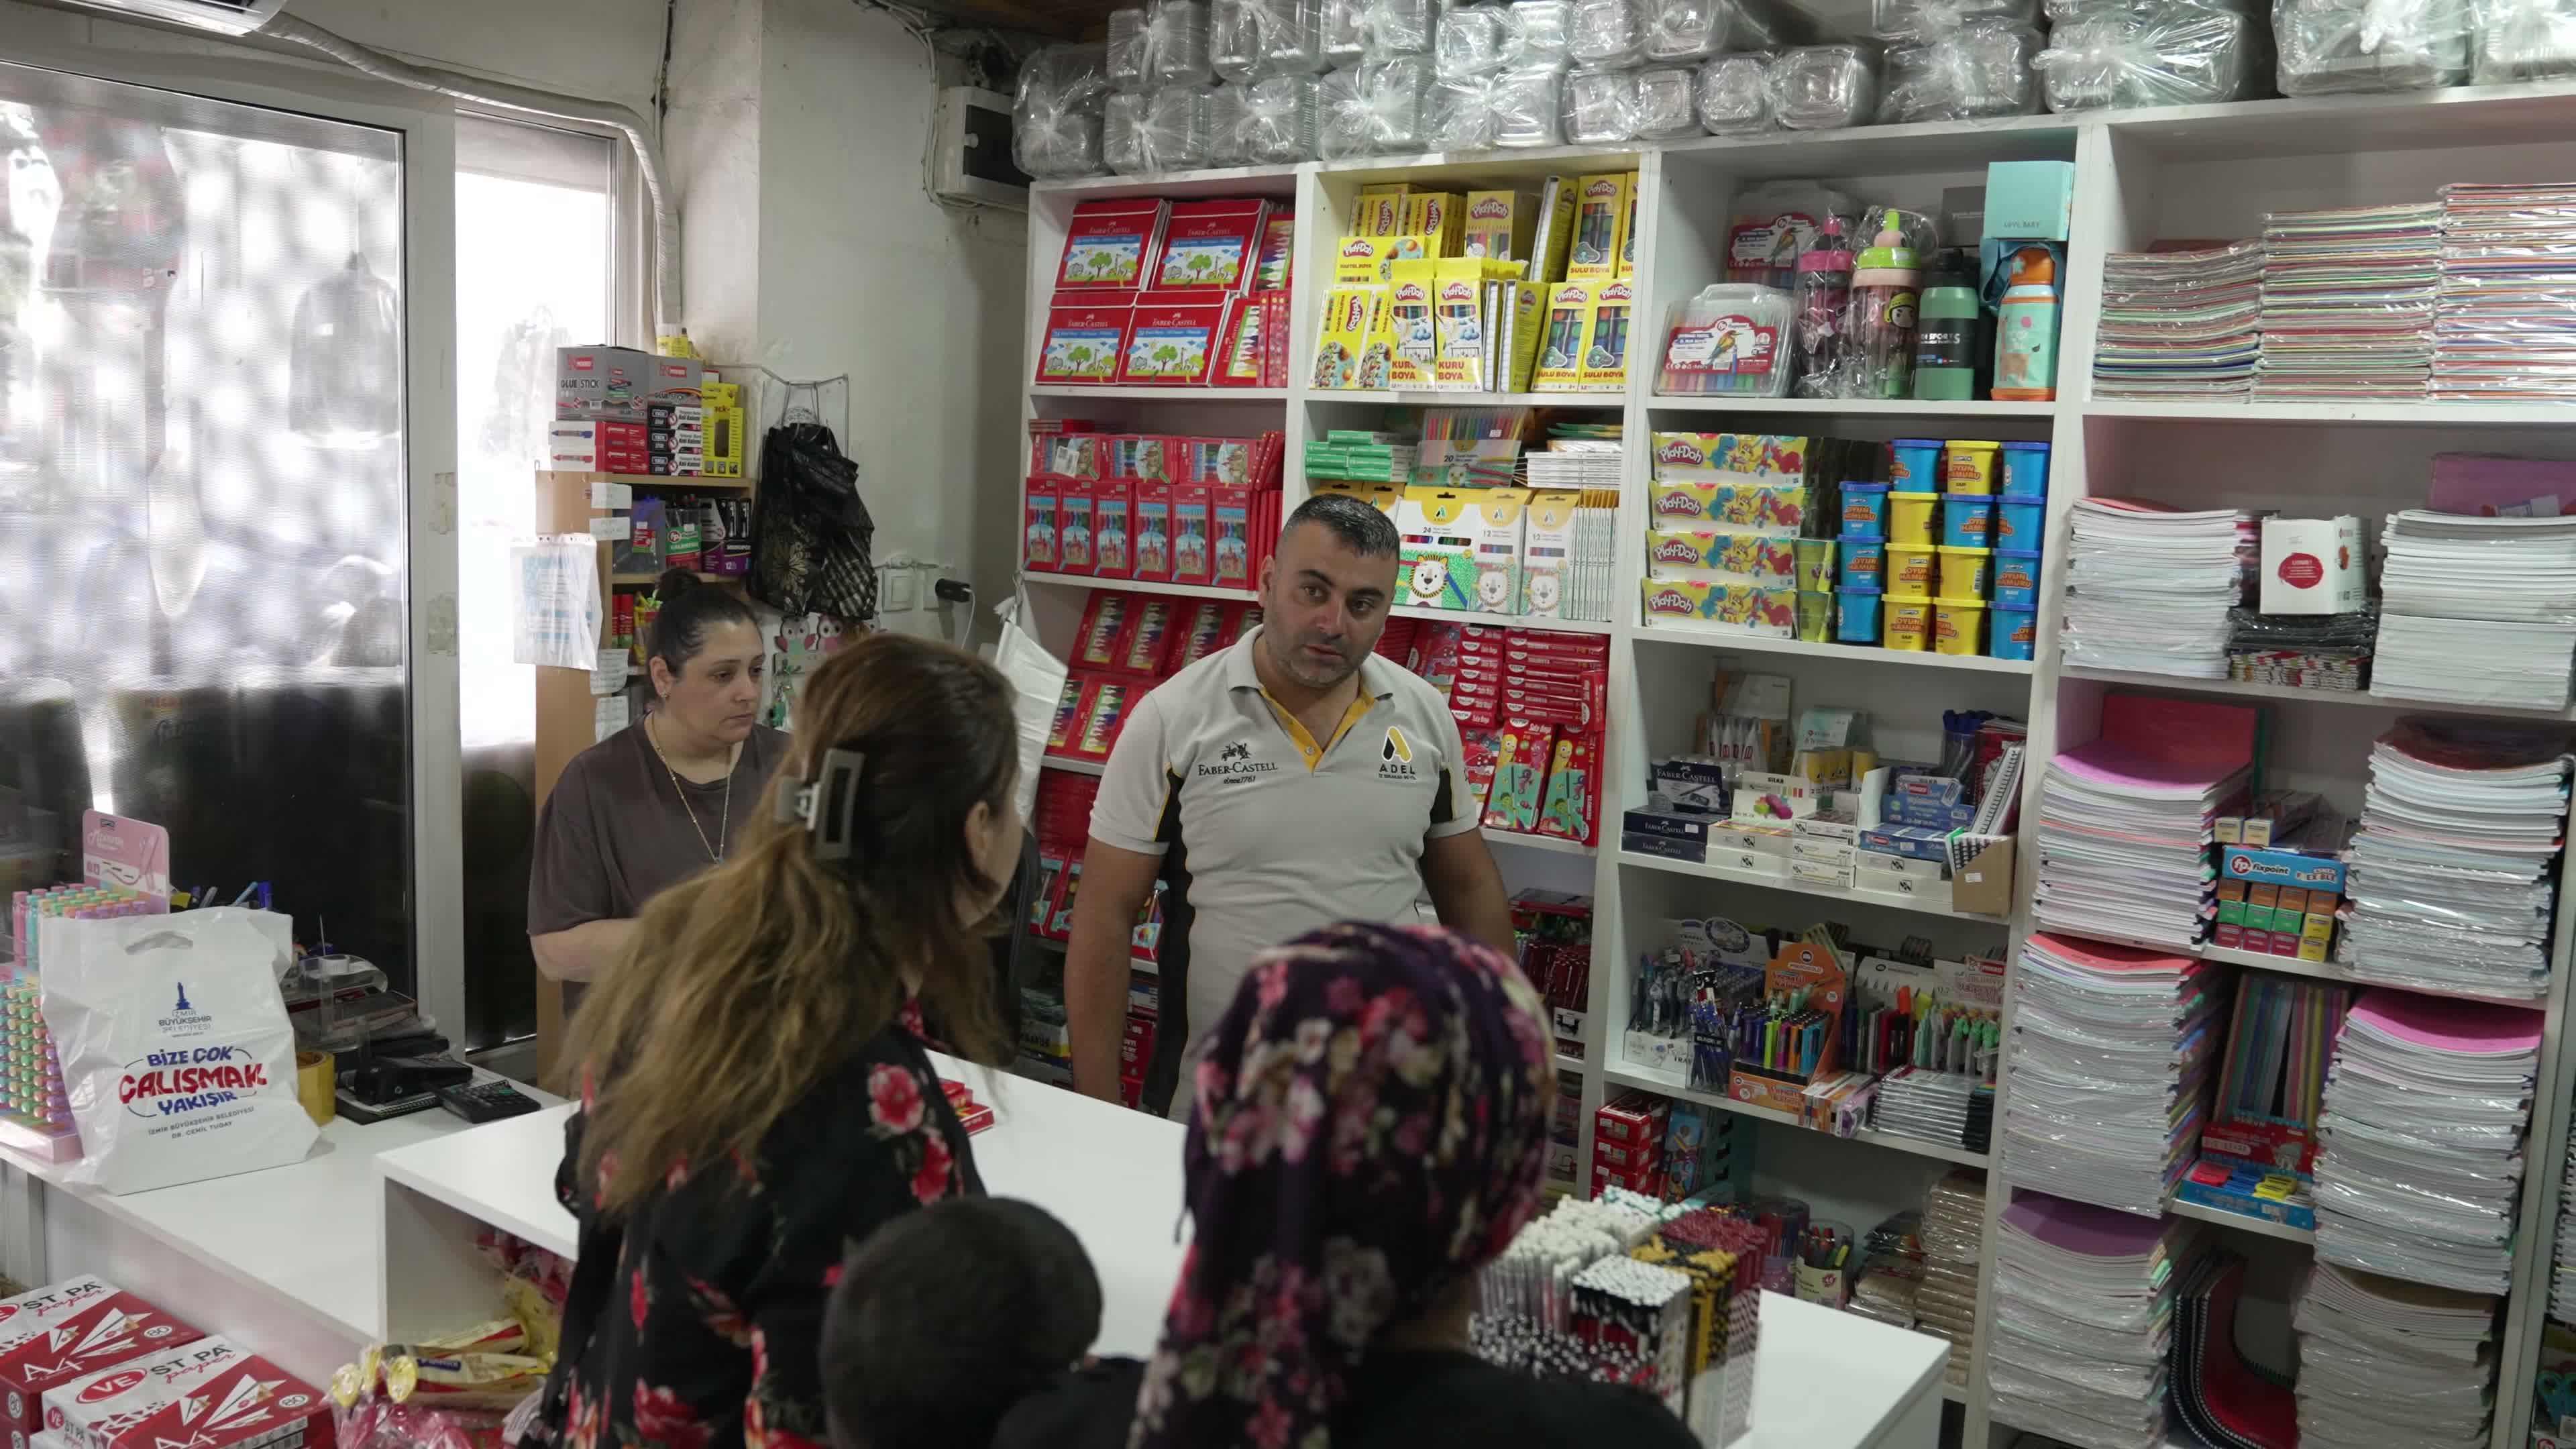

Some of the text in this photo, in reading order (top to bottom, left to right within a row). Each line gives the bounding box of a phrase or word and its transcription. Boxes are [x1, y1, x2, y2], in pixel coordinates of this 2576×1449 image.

[1438, 361, 1464, 369] KURU
[1438, 372, 1464, 380] BOYA
[1658, 445, 1703, 463] Play-Doh
[1656, 496, 1701, 514] Play-Doh
[1654, 544, 1699, 562] Play-Doh
[1649, 594, 1693, 612] Play-Doh
[1198, 762, 1277, 775] FABER-CASTELL
[1379, 763, 1415, 775] ADEL
[1657, 769, 1717, 784] FABER-CASTELL
[2253, 862, 2290, 875] fixpoint
[146, 1046, 234, 1067] BİZE ÇOK
[119, 1063, 267, 1104] ÇALIŞMAK
[157, 1090, 238, 1115] YAKIŞIR
[185, 1126, 207, 1136] CEMİL
[23, 1282, 102, 1309] ST PA
[35, 1289, 106, 1317] paper
[92, 1344, 233, 1393] VE ST PA
[164, 1353, 236, 1384] paper
[281, 1395, 305, 1407] 80
